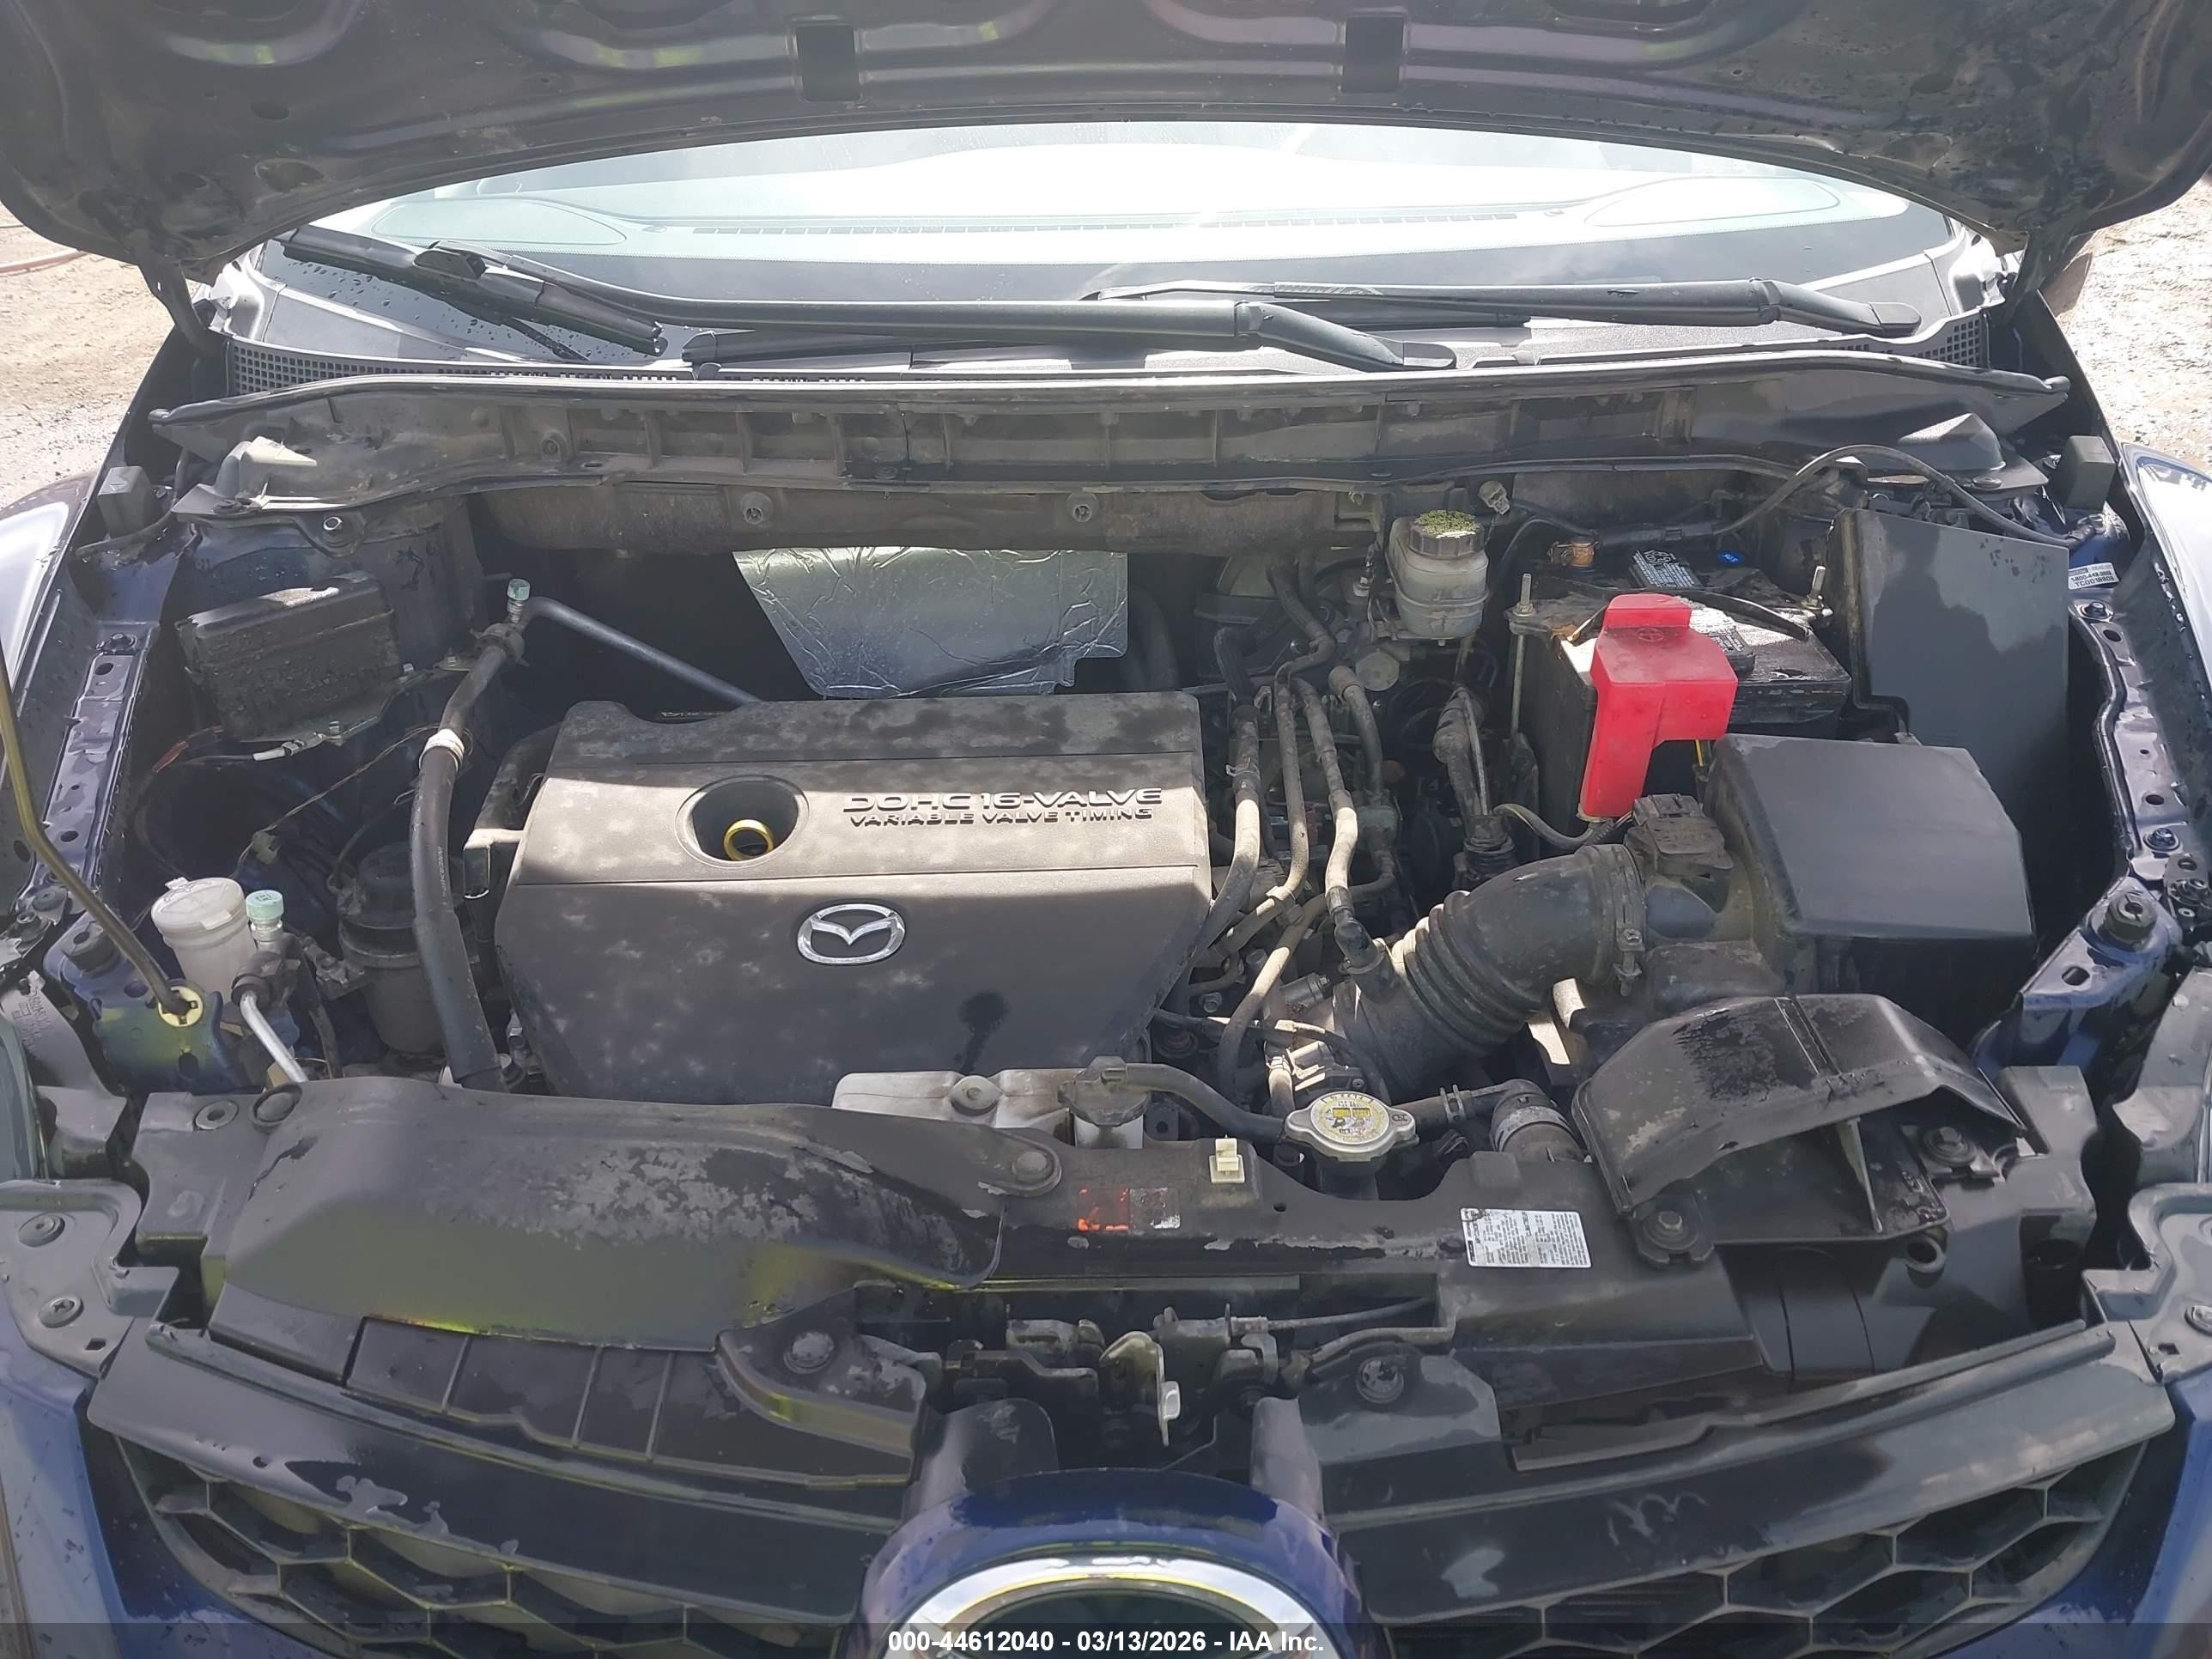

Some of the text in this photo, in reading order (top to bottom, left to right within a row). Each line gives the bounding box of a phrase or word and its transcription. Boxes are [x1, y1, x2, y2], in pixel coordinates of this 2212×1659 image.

[843, 787, 1163, 812] DOHC 16-VALVE
[850, 807, 1152, 827] VARIABLE VALVE TIMING
